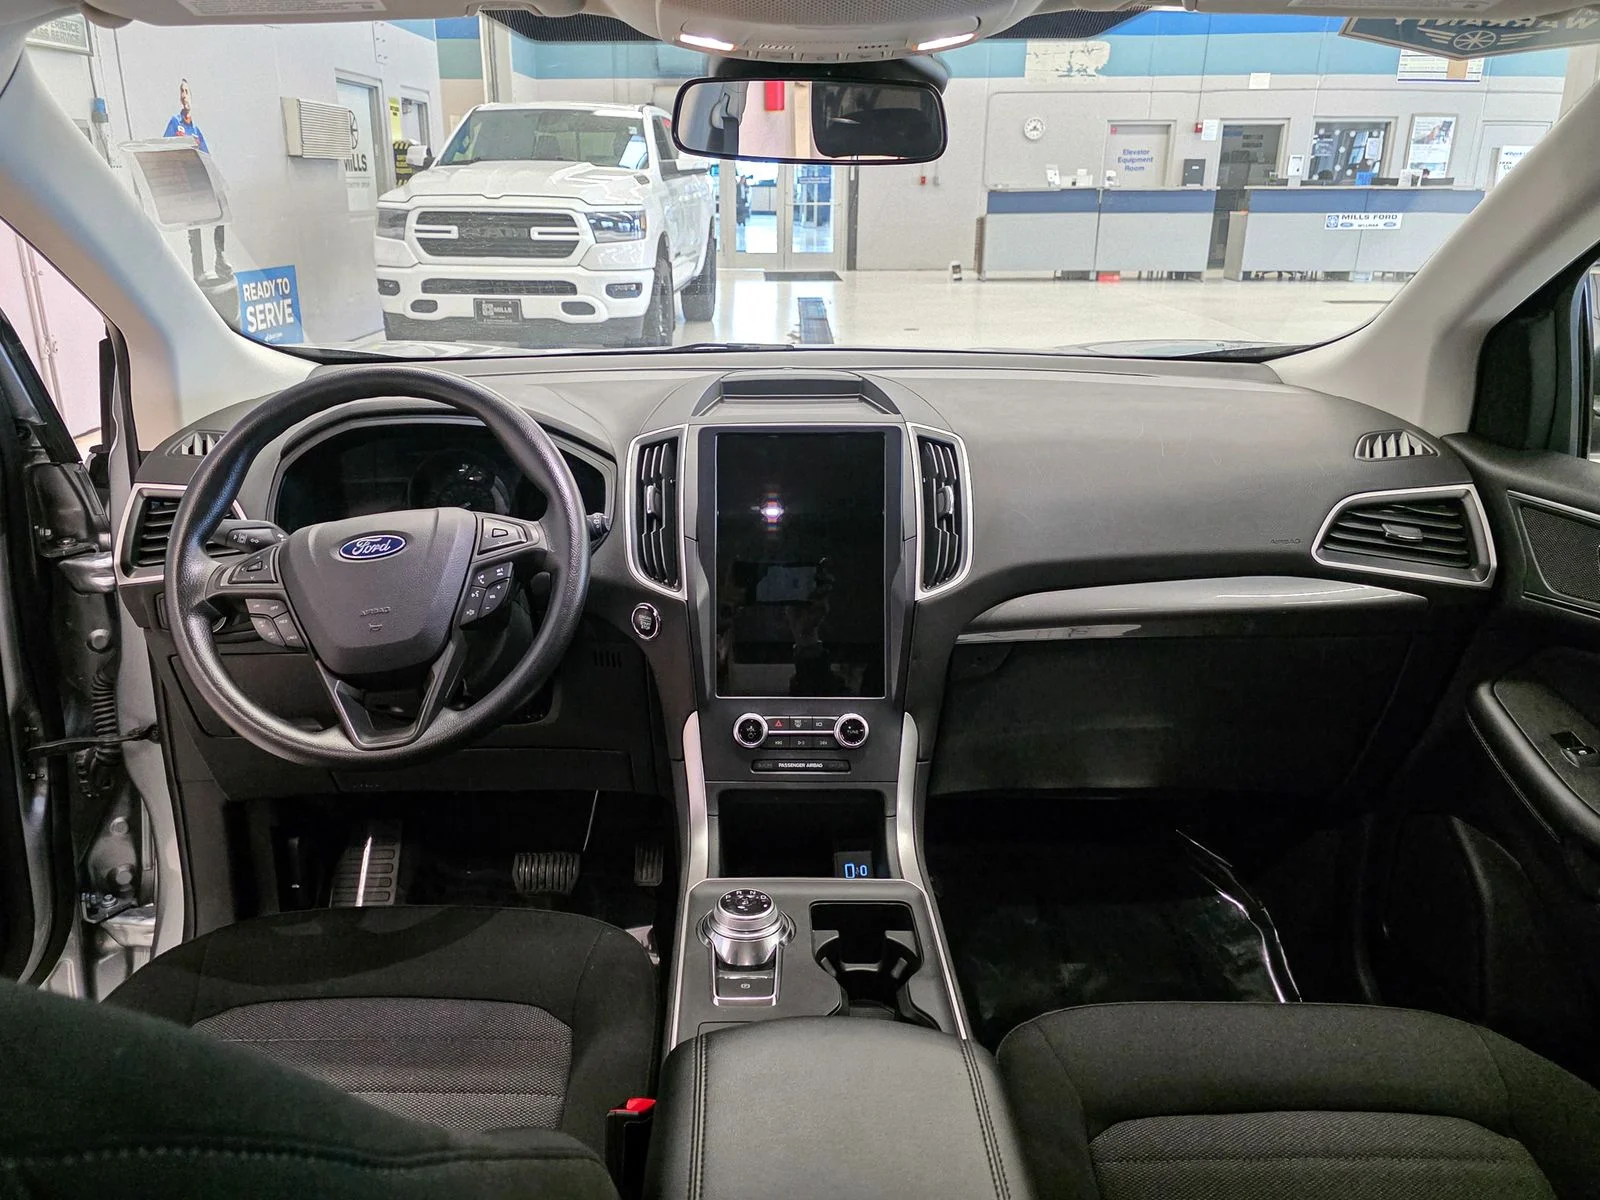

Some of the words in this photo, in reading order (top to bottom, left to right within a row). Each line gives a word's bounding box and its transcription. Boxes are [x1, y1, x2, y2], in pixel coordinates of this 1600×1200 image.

[243, 279, 276, 303] READY
[276, 277, 291, 296] TO
[246, 299, 294, 333] SERVE
[351, 536, 392, 556] Ford
